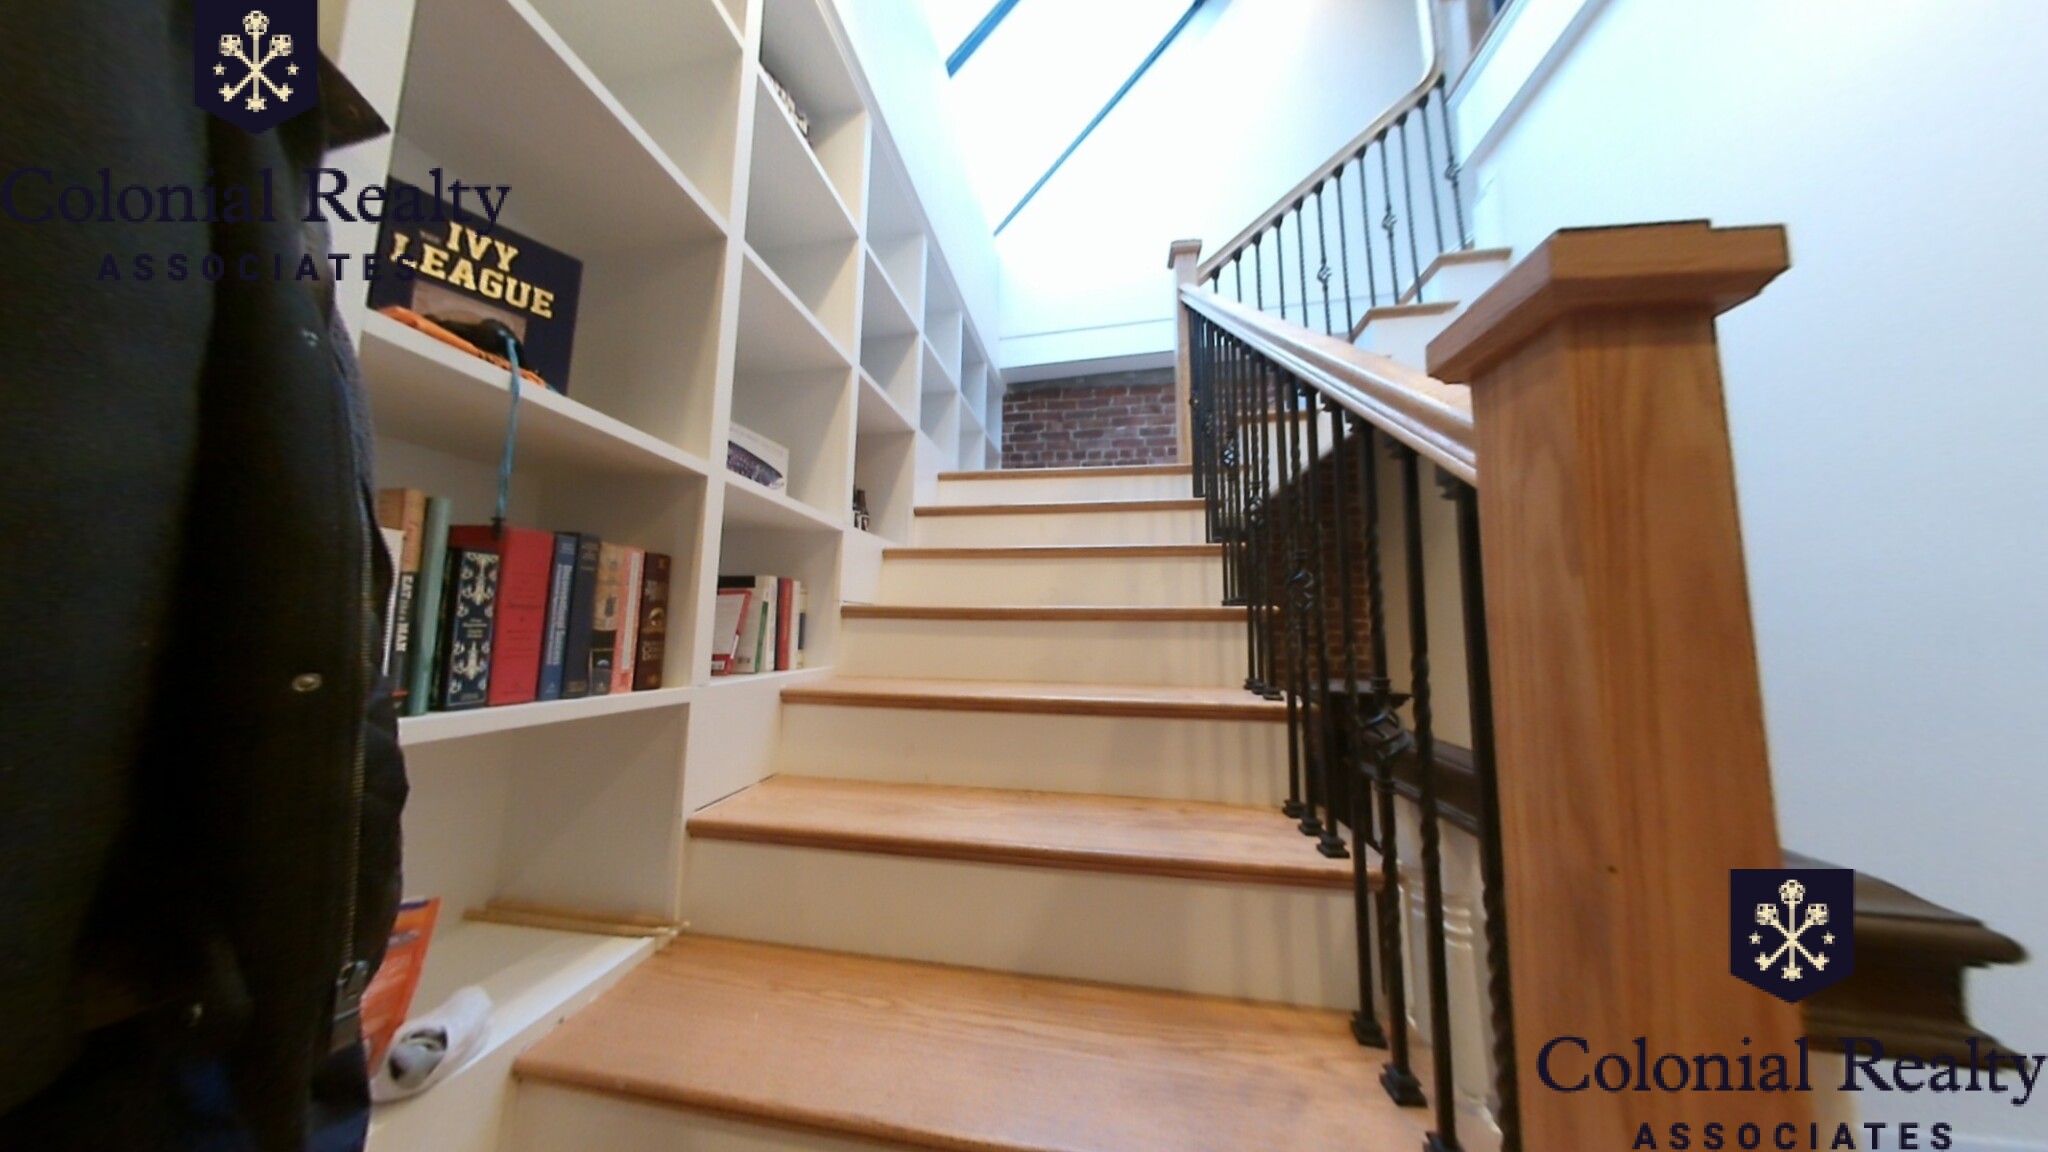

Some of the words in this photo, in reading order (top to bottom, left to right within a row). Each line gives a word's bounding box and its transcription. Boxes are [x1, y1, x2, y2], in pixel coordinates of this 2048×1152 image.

[446, 220, 519, 272] IVY
[390, 232, 555, 319] LEAGUE
[402, 574, 414, 599] EAT
[395, 623, 409, 652] MAN
